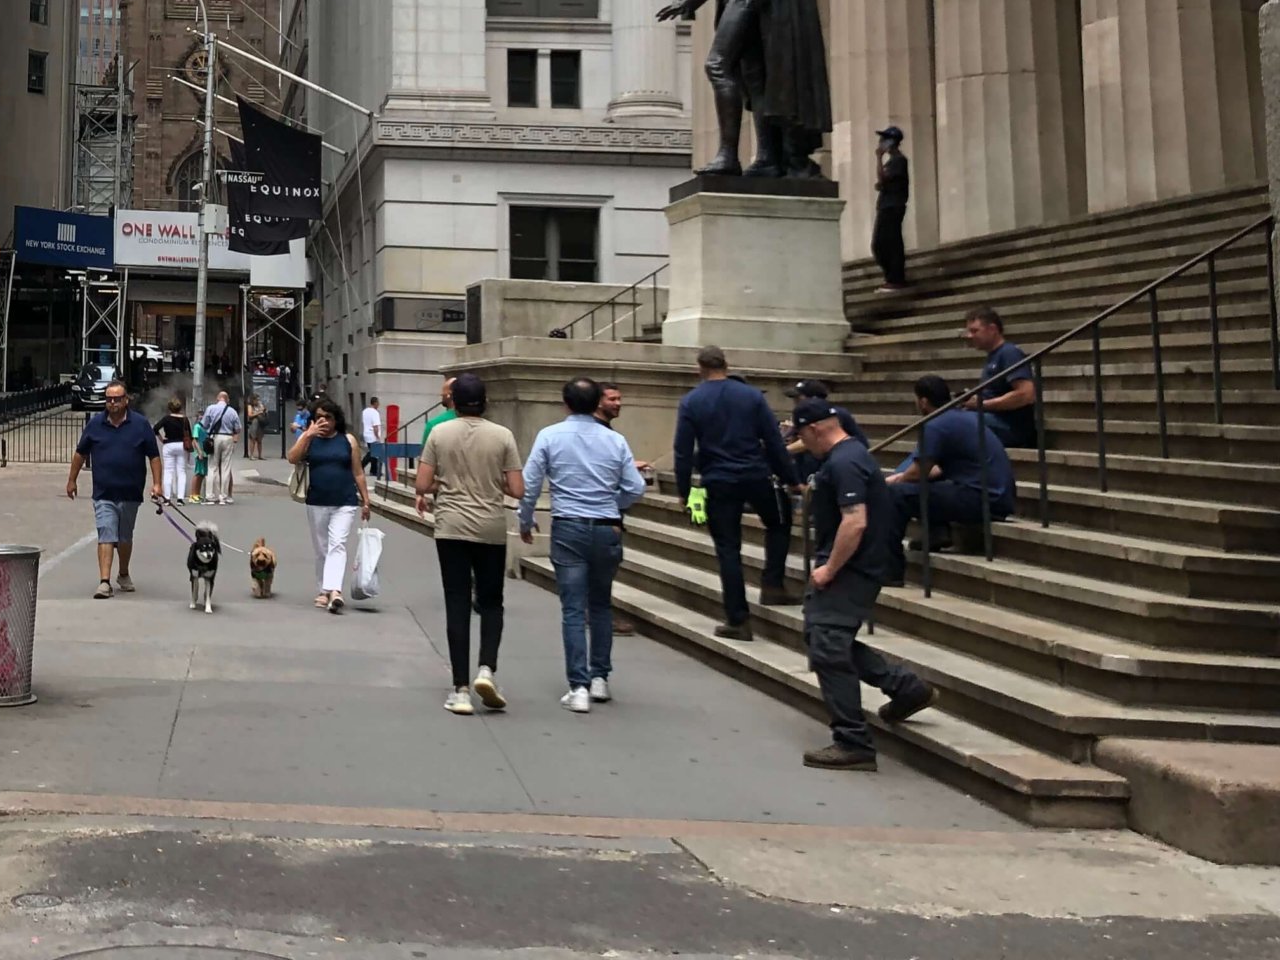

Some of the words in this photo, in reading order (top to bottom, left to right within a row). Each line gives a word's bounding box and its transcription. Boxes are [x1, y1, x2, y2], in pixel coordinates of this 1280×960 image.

[228, 174, 257, 184] NASSAU
[250, 184, 320, 197] EQUINOX
[122, 223, 152, 237] ONE
[158, 224, 195, 239] WALL
[231, 226, 245, 237] EQ
[25, 240, 39, 248] NEW
[41, 241, 55, 249] YORK
[56, 243, 75, 252] STOCK
[76, 245, 106, 256] EXCHANGE
